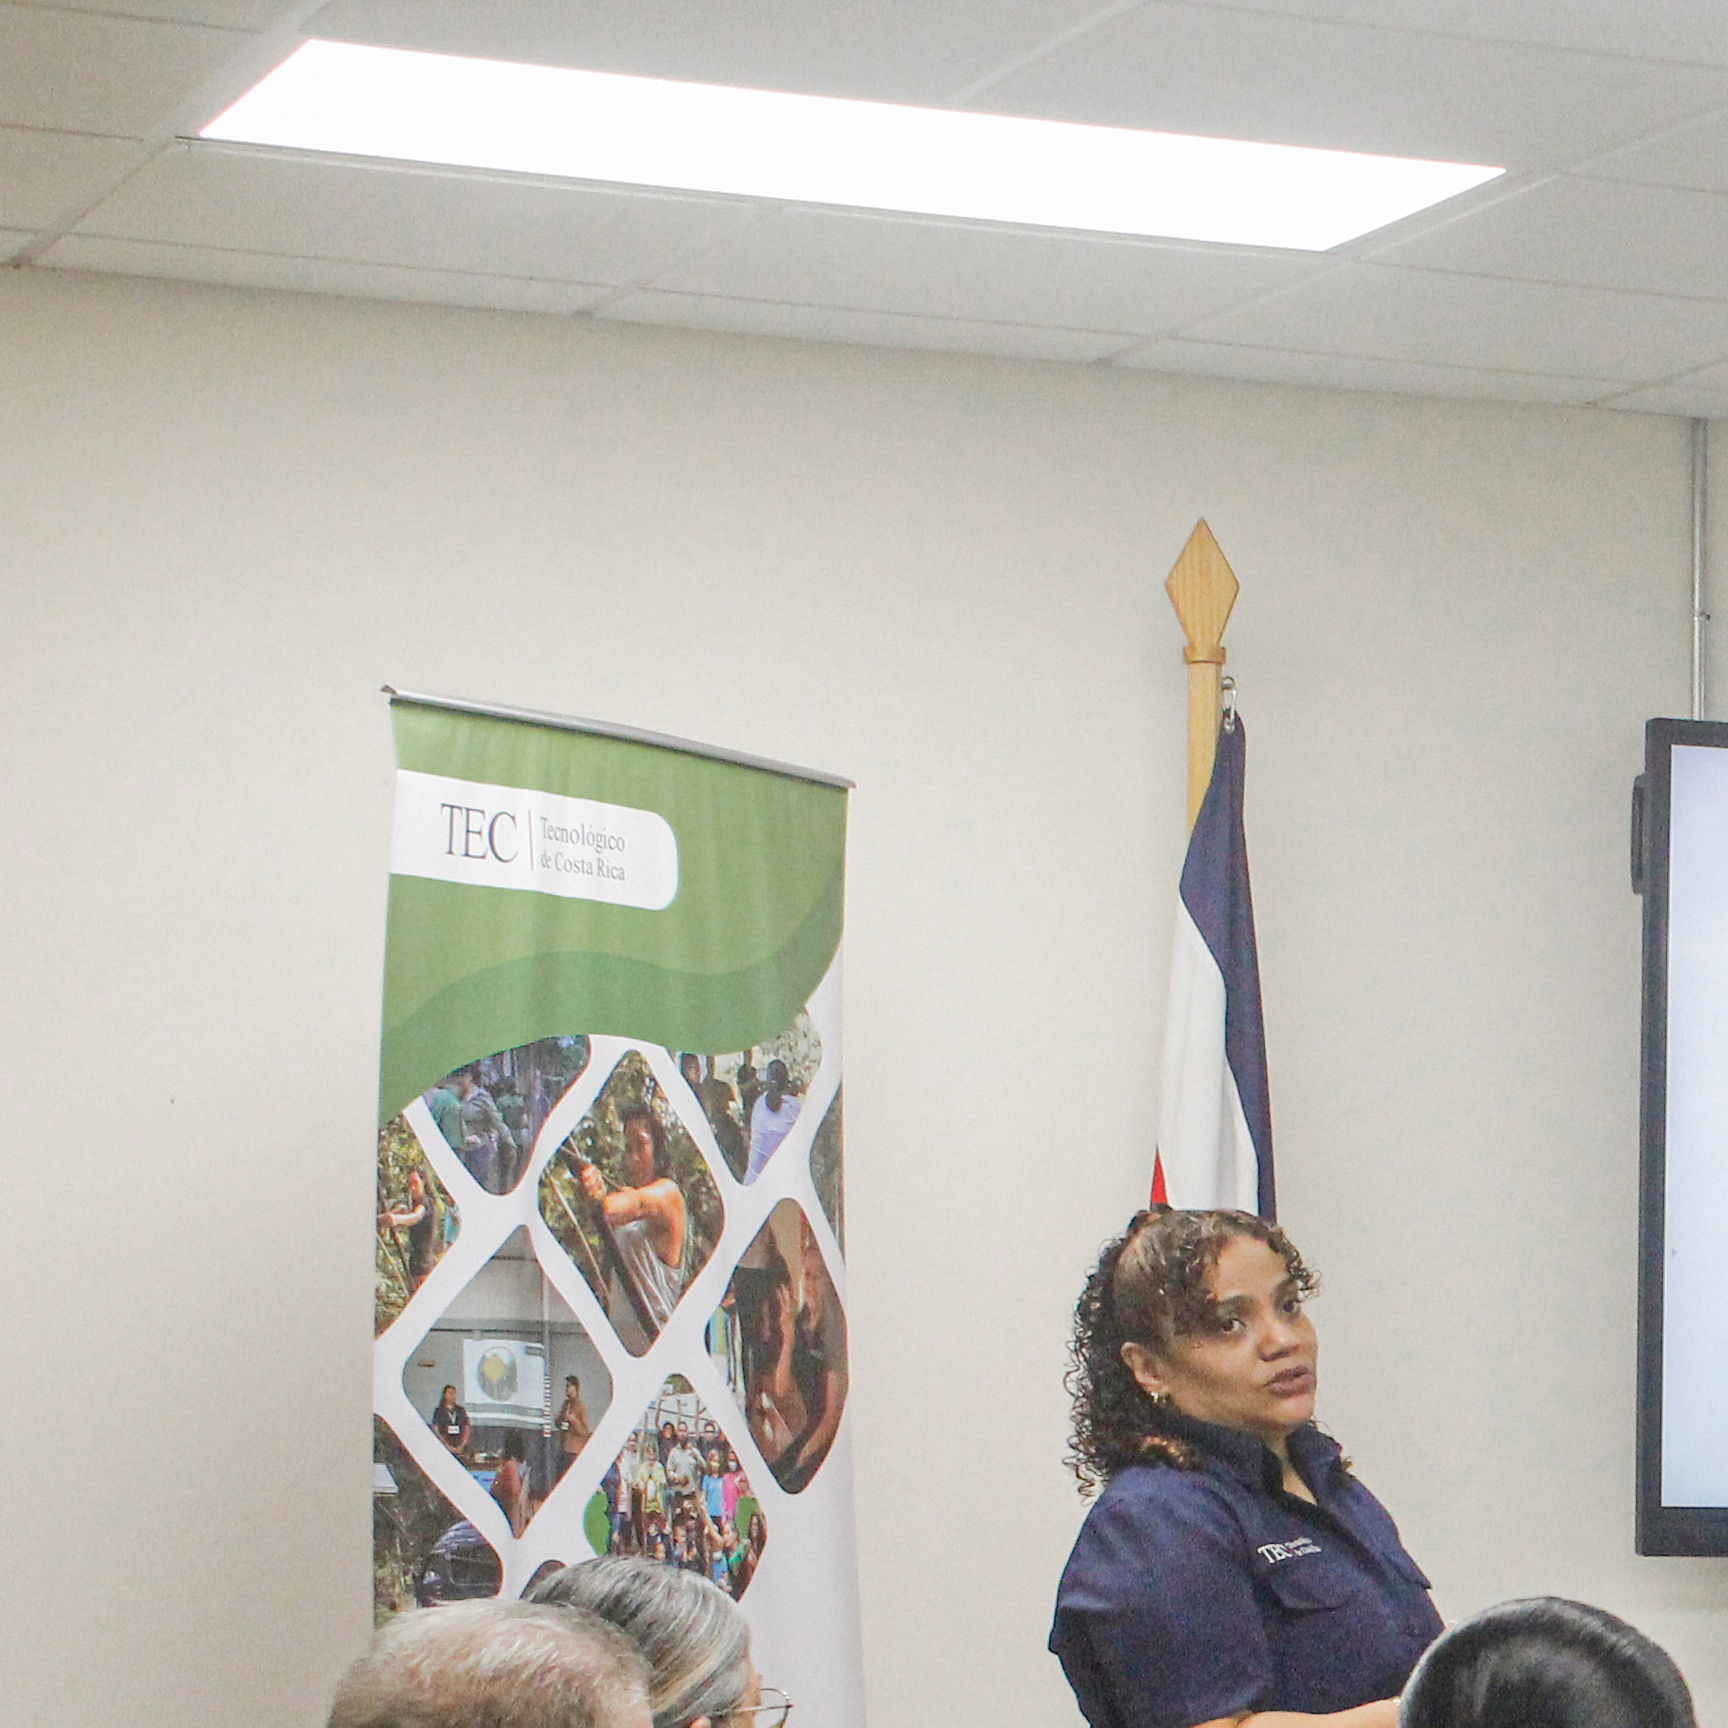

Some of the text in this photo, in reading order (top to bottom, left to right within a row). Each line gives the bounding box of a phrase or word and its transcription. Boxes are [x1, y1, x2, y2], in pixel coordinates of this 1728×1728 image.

[440, 802, 519, 864] TEC
[540, 815, 626, 854] Tecnológico
[541, 849, 626, 882] de Costa Rica
